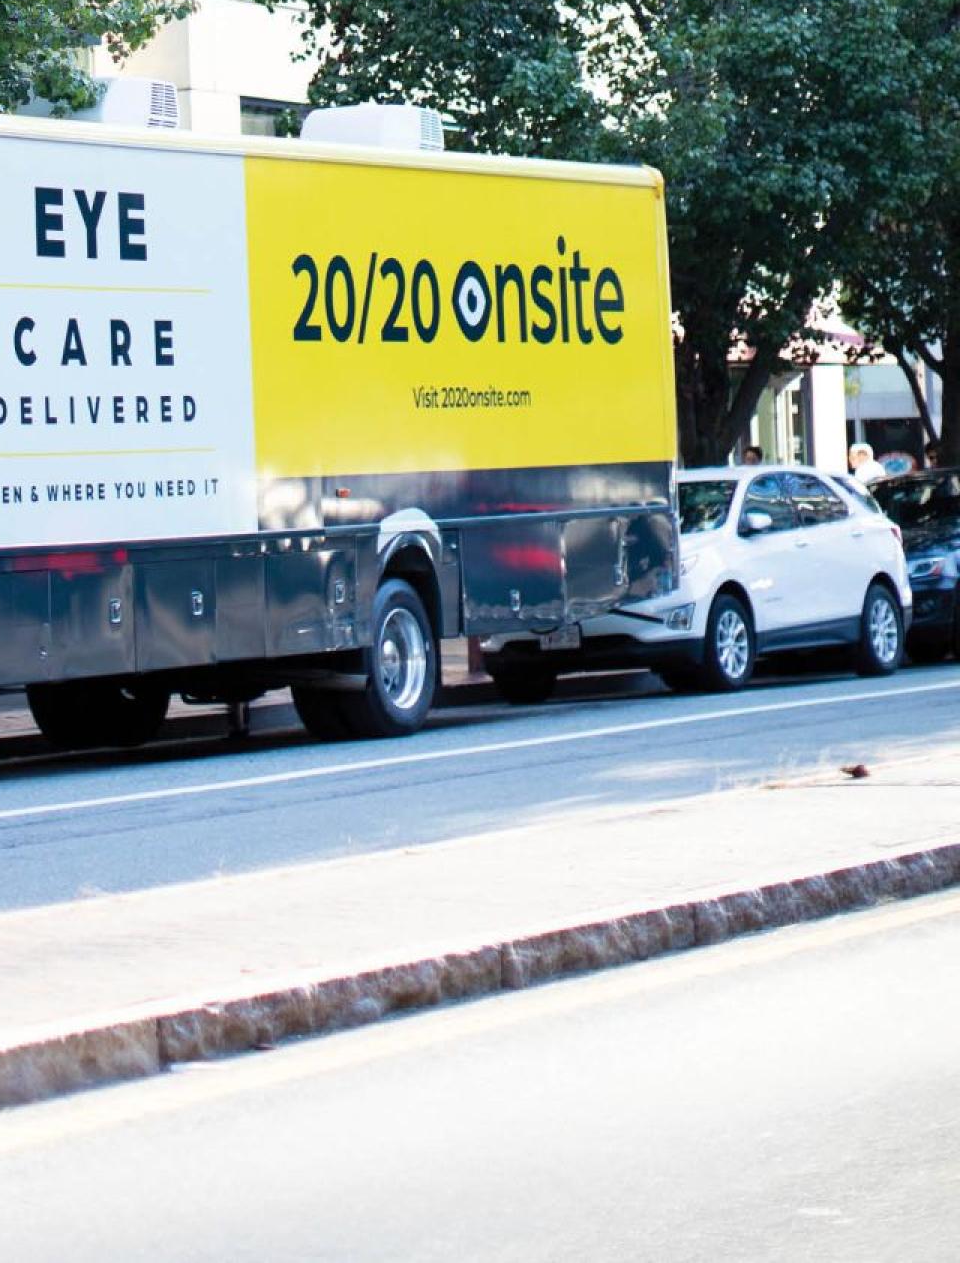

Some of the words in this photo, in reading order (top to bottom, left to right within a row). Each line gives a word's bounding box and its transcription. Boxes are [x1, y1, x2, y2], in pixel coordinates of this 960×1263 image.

[35, 186, 148, 262] EYE
[291, 252, 441, 345] 20/20
[451, 235, 625, 346] onsite
[13, 316, 175, 367] CARE
[413, 385, 440, 409] Visit
[441, 385, 532, 409] 2020onsite.com
[30, 485, 40, 503] &
[46, 482, 106, 502] WHERE
[114, 480, 147, 500] YOU
[155, 479, 196, 497] NEED
[204, 478, 219, 495] IT
